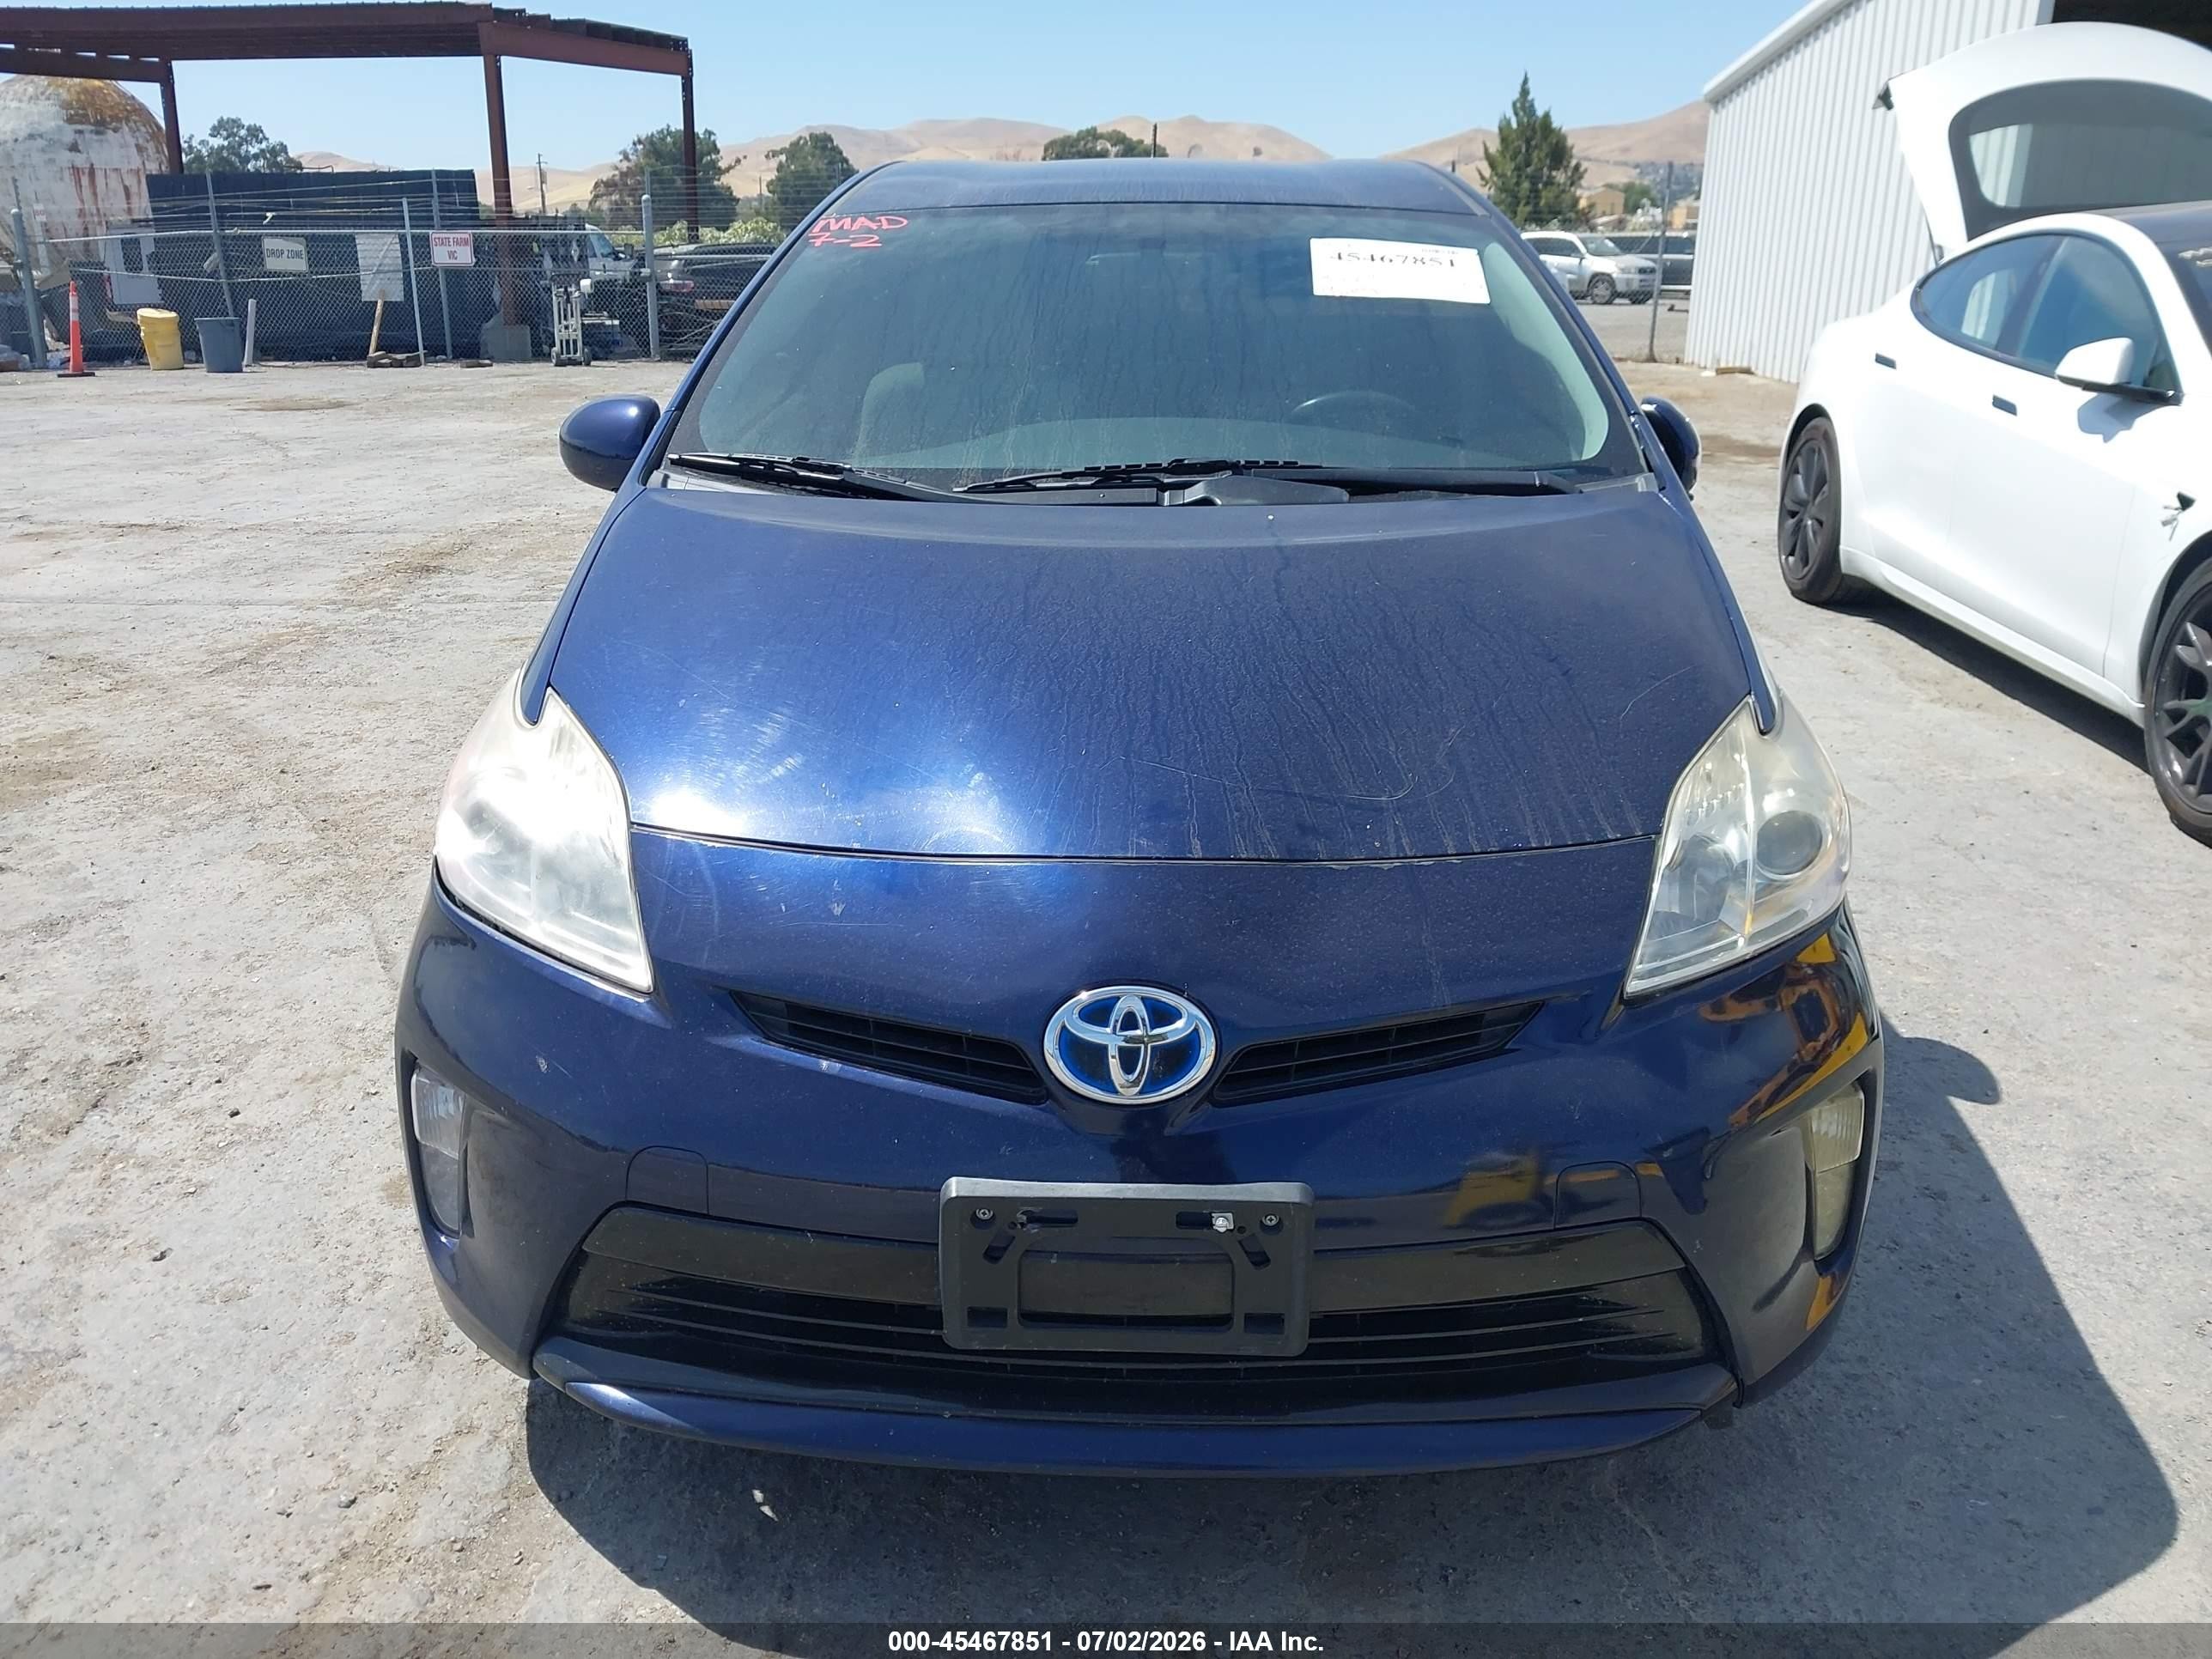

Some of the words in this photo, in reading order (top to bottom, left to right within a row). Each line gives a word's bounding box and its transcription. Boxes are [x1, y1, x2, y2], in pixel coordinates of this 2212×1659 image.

[811, 215, 908, 233] MAD
[433, 236, 451, 247] STATE
[452, 236, 470, 247] FARM
[266, 247, 285, 259] DROP
[286, 248, 305, 260] ZONE
